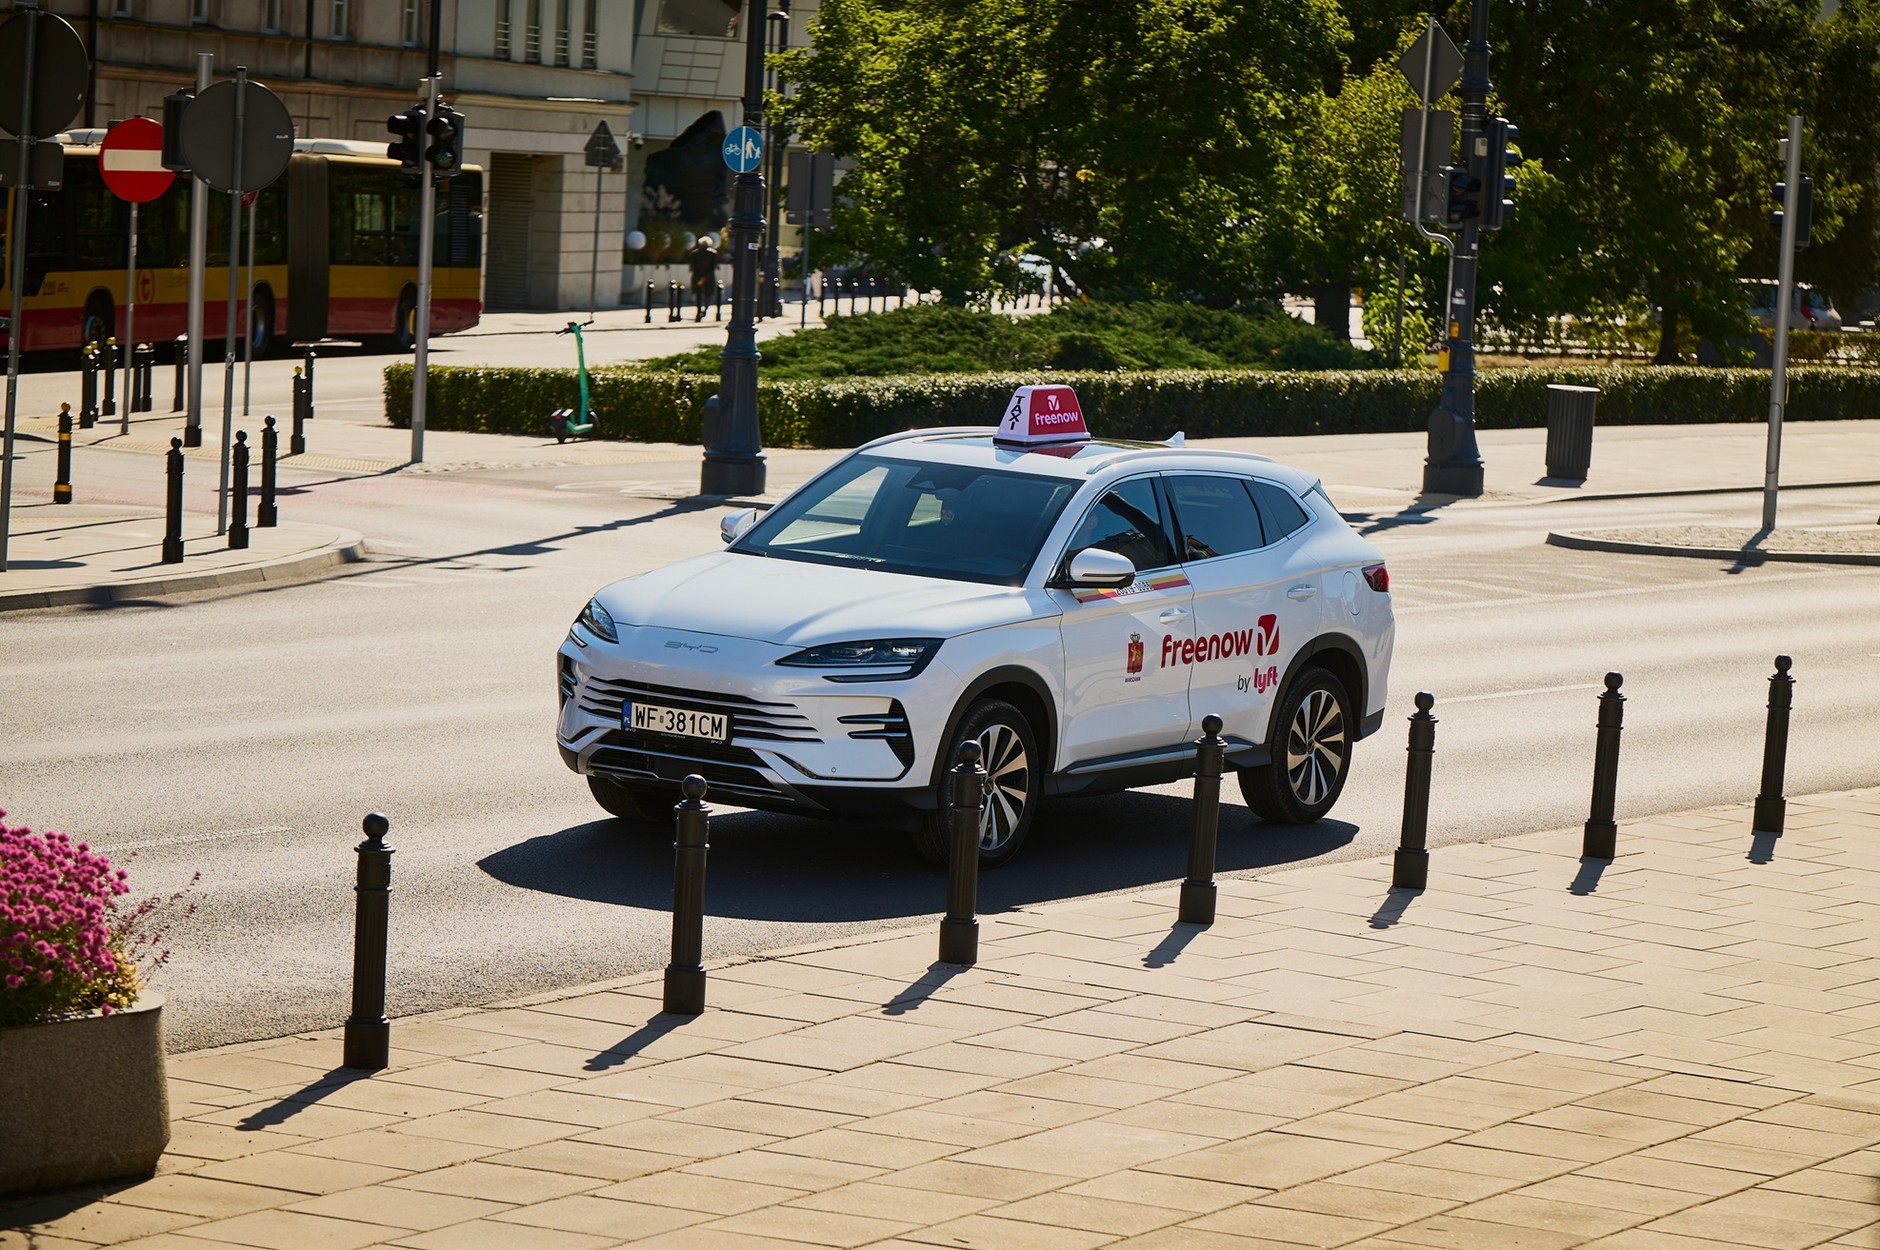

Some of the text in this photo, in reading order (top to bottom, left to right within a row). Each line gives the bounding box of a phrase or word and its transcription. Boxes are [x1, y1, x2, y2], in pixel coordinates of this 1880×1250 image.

[1009, 395, 1026, 431] TAXI
[1034, 411, 1079, 426] freenow
[1160, 628, 1254, 669] freenow
[1237, 665, 1278, 694] by lyft
[635, 705, 723, 738] WF 381CM
